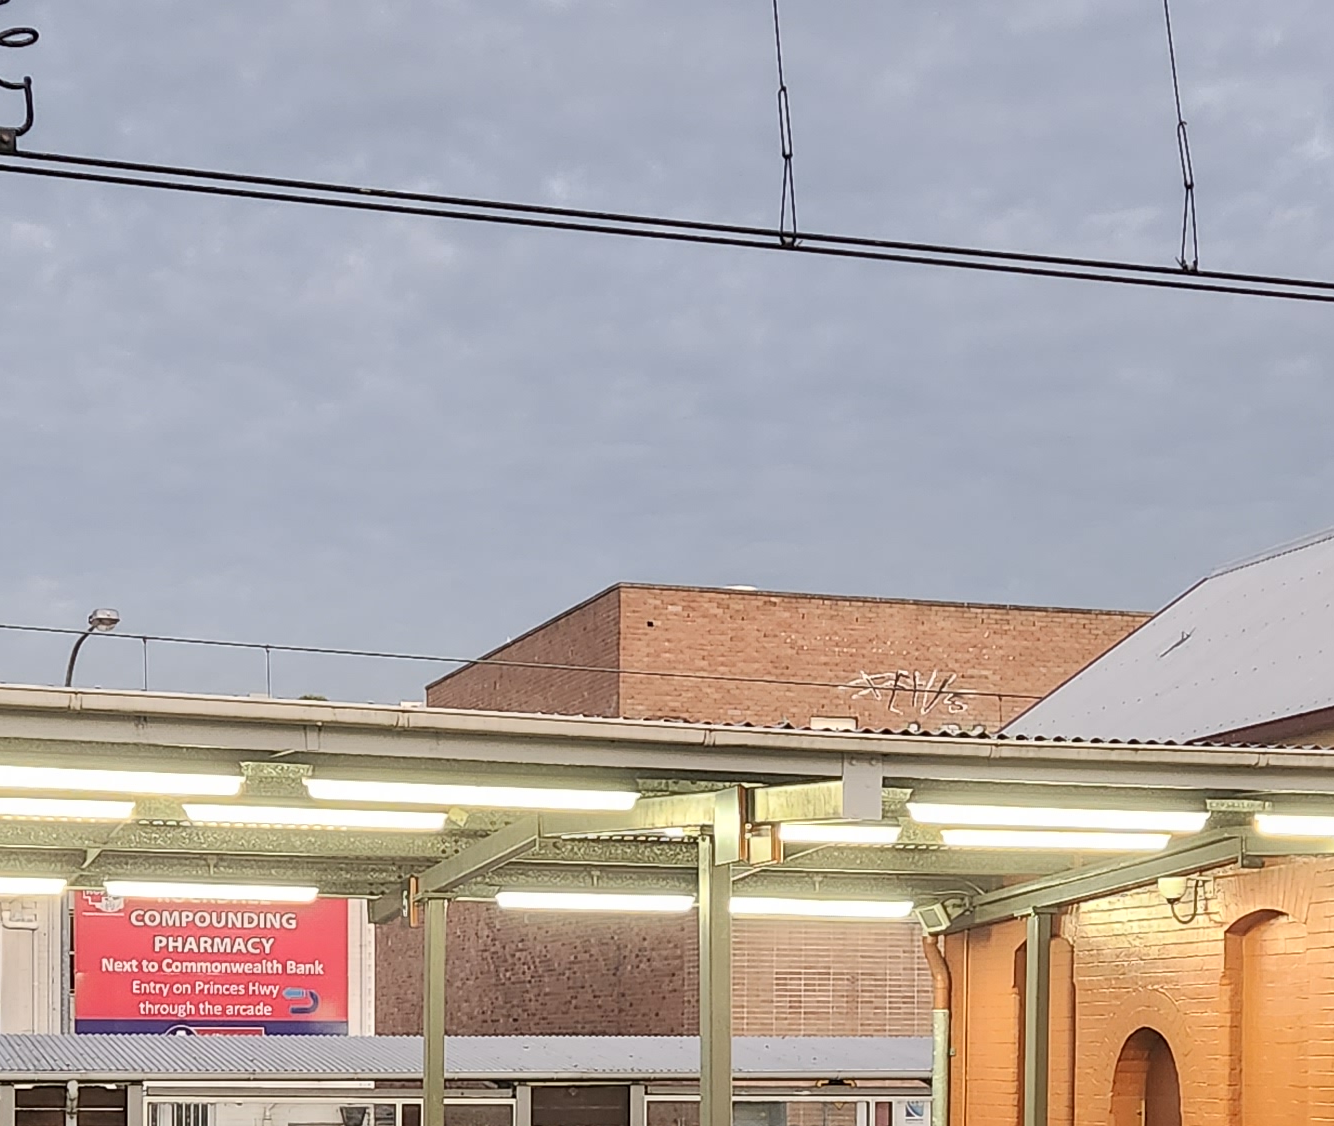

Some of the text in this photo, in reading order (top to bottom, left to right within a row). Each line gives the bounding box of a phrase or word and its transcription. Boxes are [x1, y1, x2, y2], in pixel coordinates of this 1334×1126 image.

[130, 910, 297, 929] COMPOUNDING
[154, 936, 275, 954] PHARMACY
[101, 958, 324, 975] Next to Commonwealth Bank
[132, 981, 280, 999] Entry on Princes Hwy
[138, 1001, 273, 1017] through the arcade
